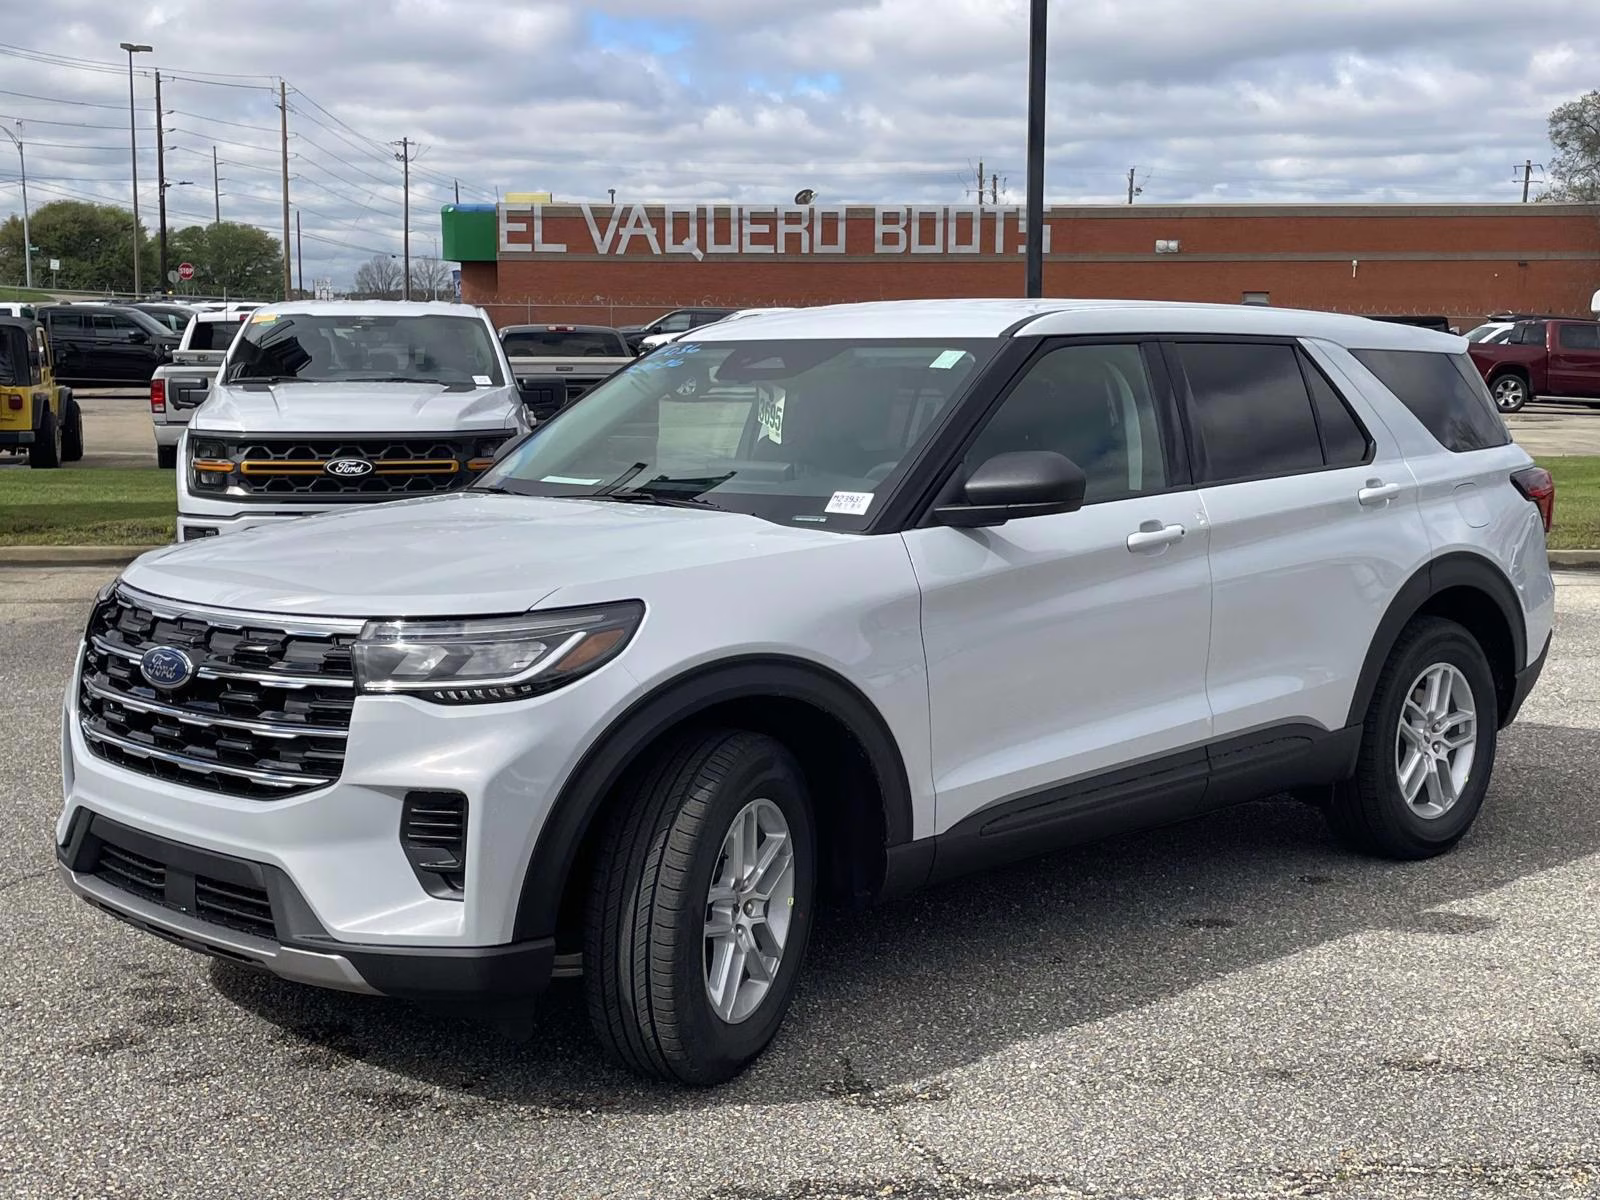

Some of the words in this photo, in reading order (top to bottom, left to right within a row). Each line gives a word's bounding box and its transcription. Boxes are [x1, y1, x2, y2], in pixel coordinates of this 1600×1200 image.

[499, 203, 568, 253] EL
[580, 203, 847, 262] VAQUERO
[874, 204, 1052, 254] BOOTS
[179, 267, 193, 275] STOP
[758, 398, 783, 432] 3695
[335, 461, 364, 474] Ford
[147, 653, 178, 680] Ford
